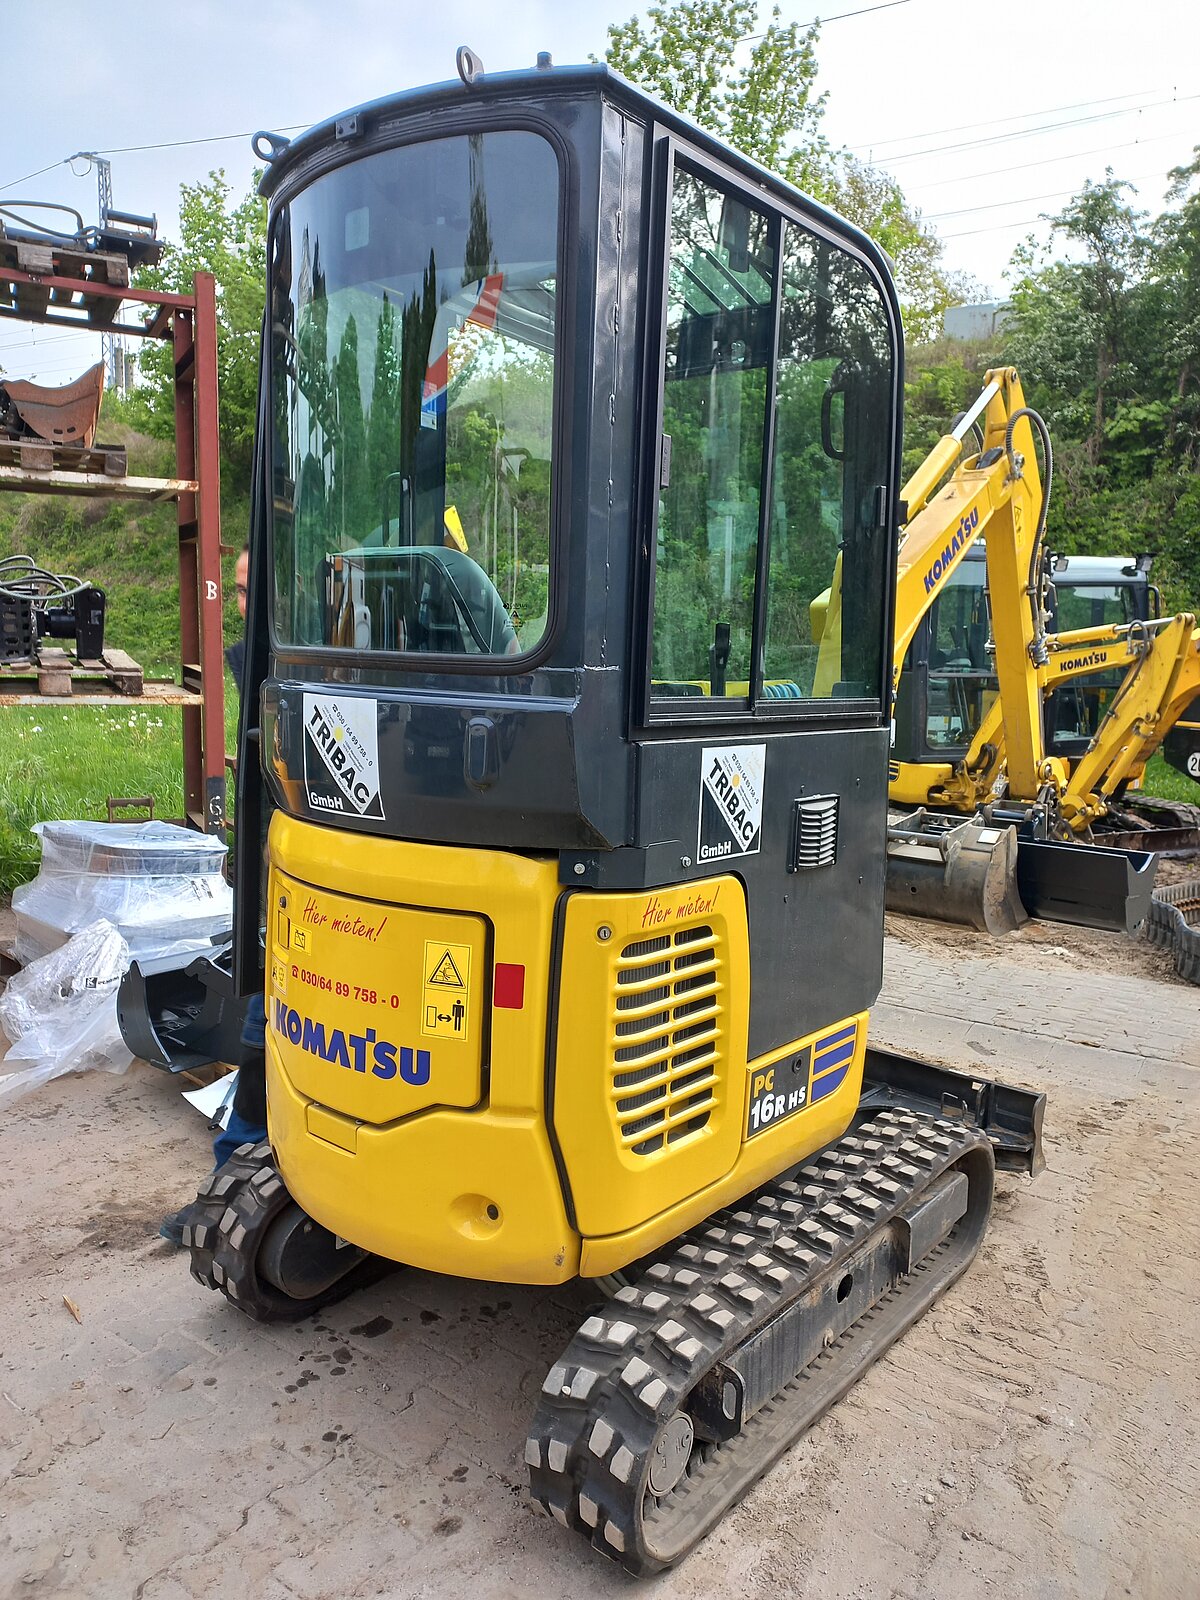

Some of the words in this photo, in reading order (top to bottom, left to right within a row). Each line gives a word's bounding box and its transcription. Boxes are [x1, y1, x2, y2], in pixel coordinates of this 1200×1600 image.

[923, 506, 979, 595] KOMATSU
[205, 580, 218, 600] B
[1060, 651, 1107, 672] KOMATSU
[310, 704, 370, 804] TRIBAC
[1190, 757, 1200, 772] 2
[310, 791, 344, 810] GmbH
[709, 757, 754, 841] TRIBAC
[700, 840, 732, 858] GmbH
[302, 896, 328, 925] Hier
[331, 914, 388, 942] mieten!
[642, 897, 672, 928] Hier
[676, 885, 720, 919] mieten!
[301, 969, 332, 992] 030/64
[335, 981, 350, 997] 89
[353, 986, 377, 1004] 758
[390, 994, 400, 1009] 0
[275, 997, 431, 1085] KOMATSU
[753, 1069, 775, 1098] PC
[751, 1093, 785, 1129] 16R
[788, 1086, 806, 1110] HS
